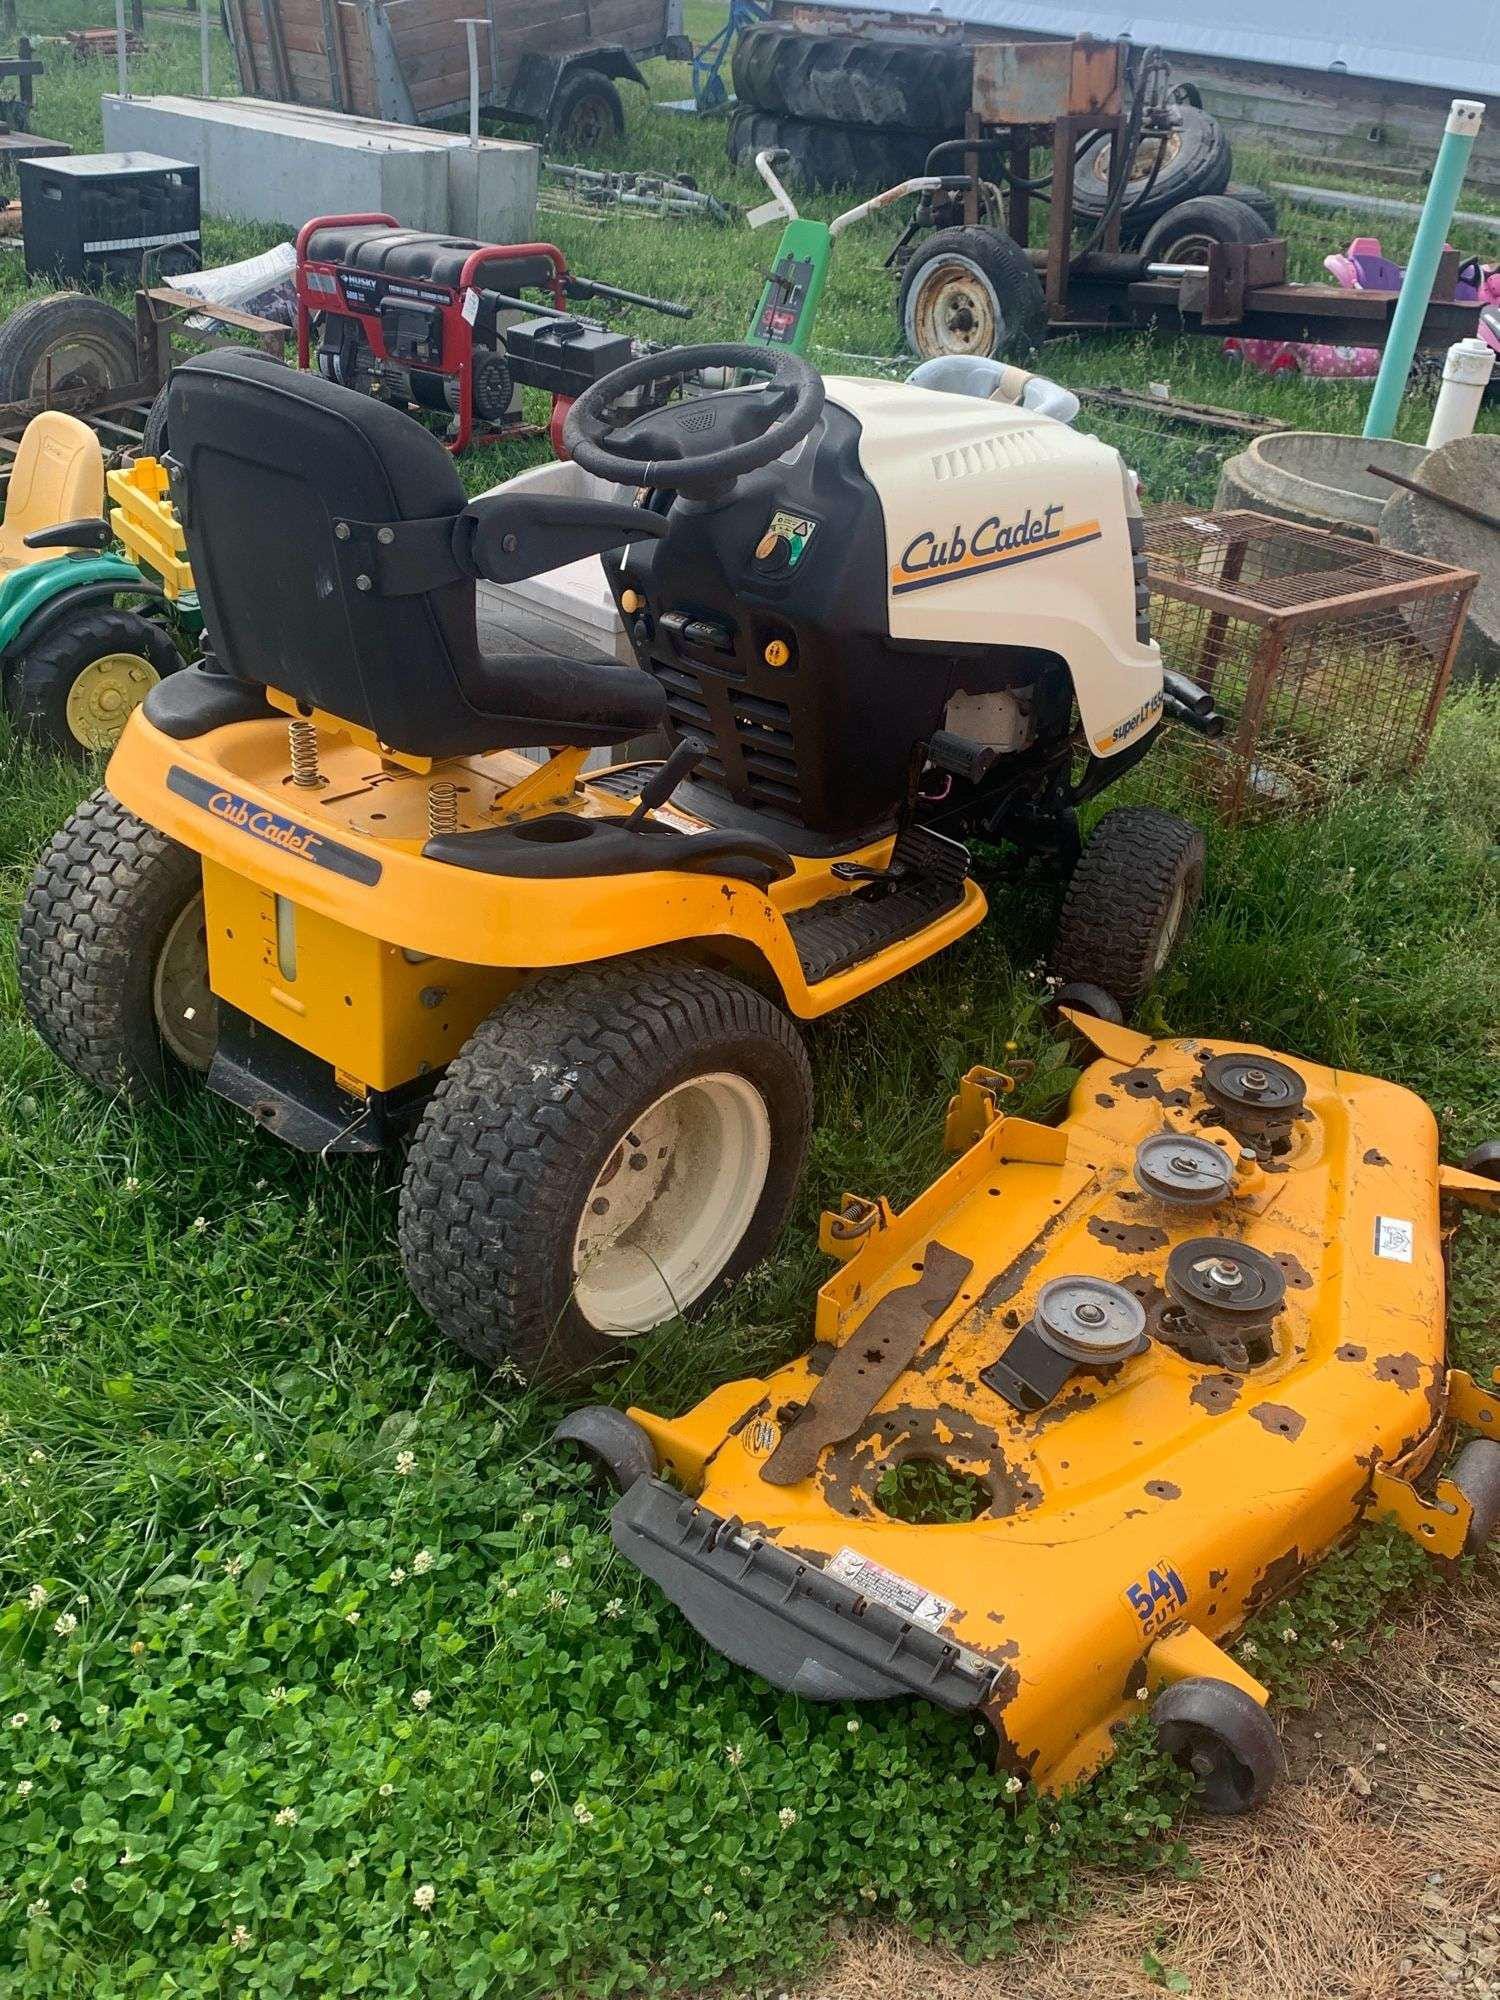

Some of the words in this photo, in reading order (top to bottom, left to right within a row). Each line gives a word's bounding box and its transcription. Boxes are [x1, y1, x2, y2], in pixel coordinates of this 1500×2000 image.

[348, 275, 376, 288] HUSKY
[901, 525, 967, 573] Cub
[970, 504, 1064, 556] Cadet
[1112, 713, 1140, 743] super
[208, 791, 249, 824] Cub
[248, 811, 323, 860] Cadet
[1142, 1597, 1177, 1636] CUT
